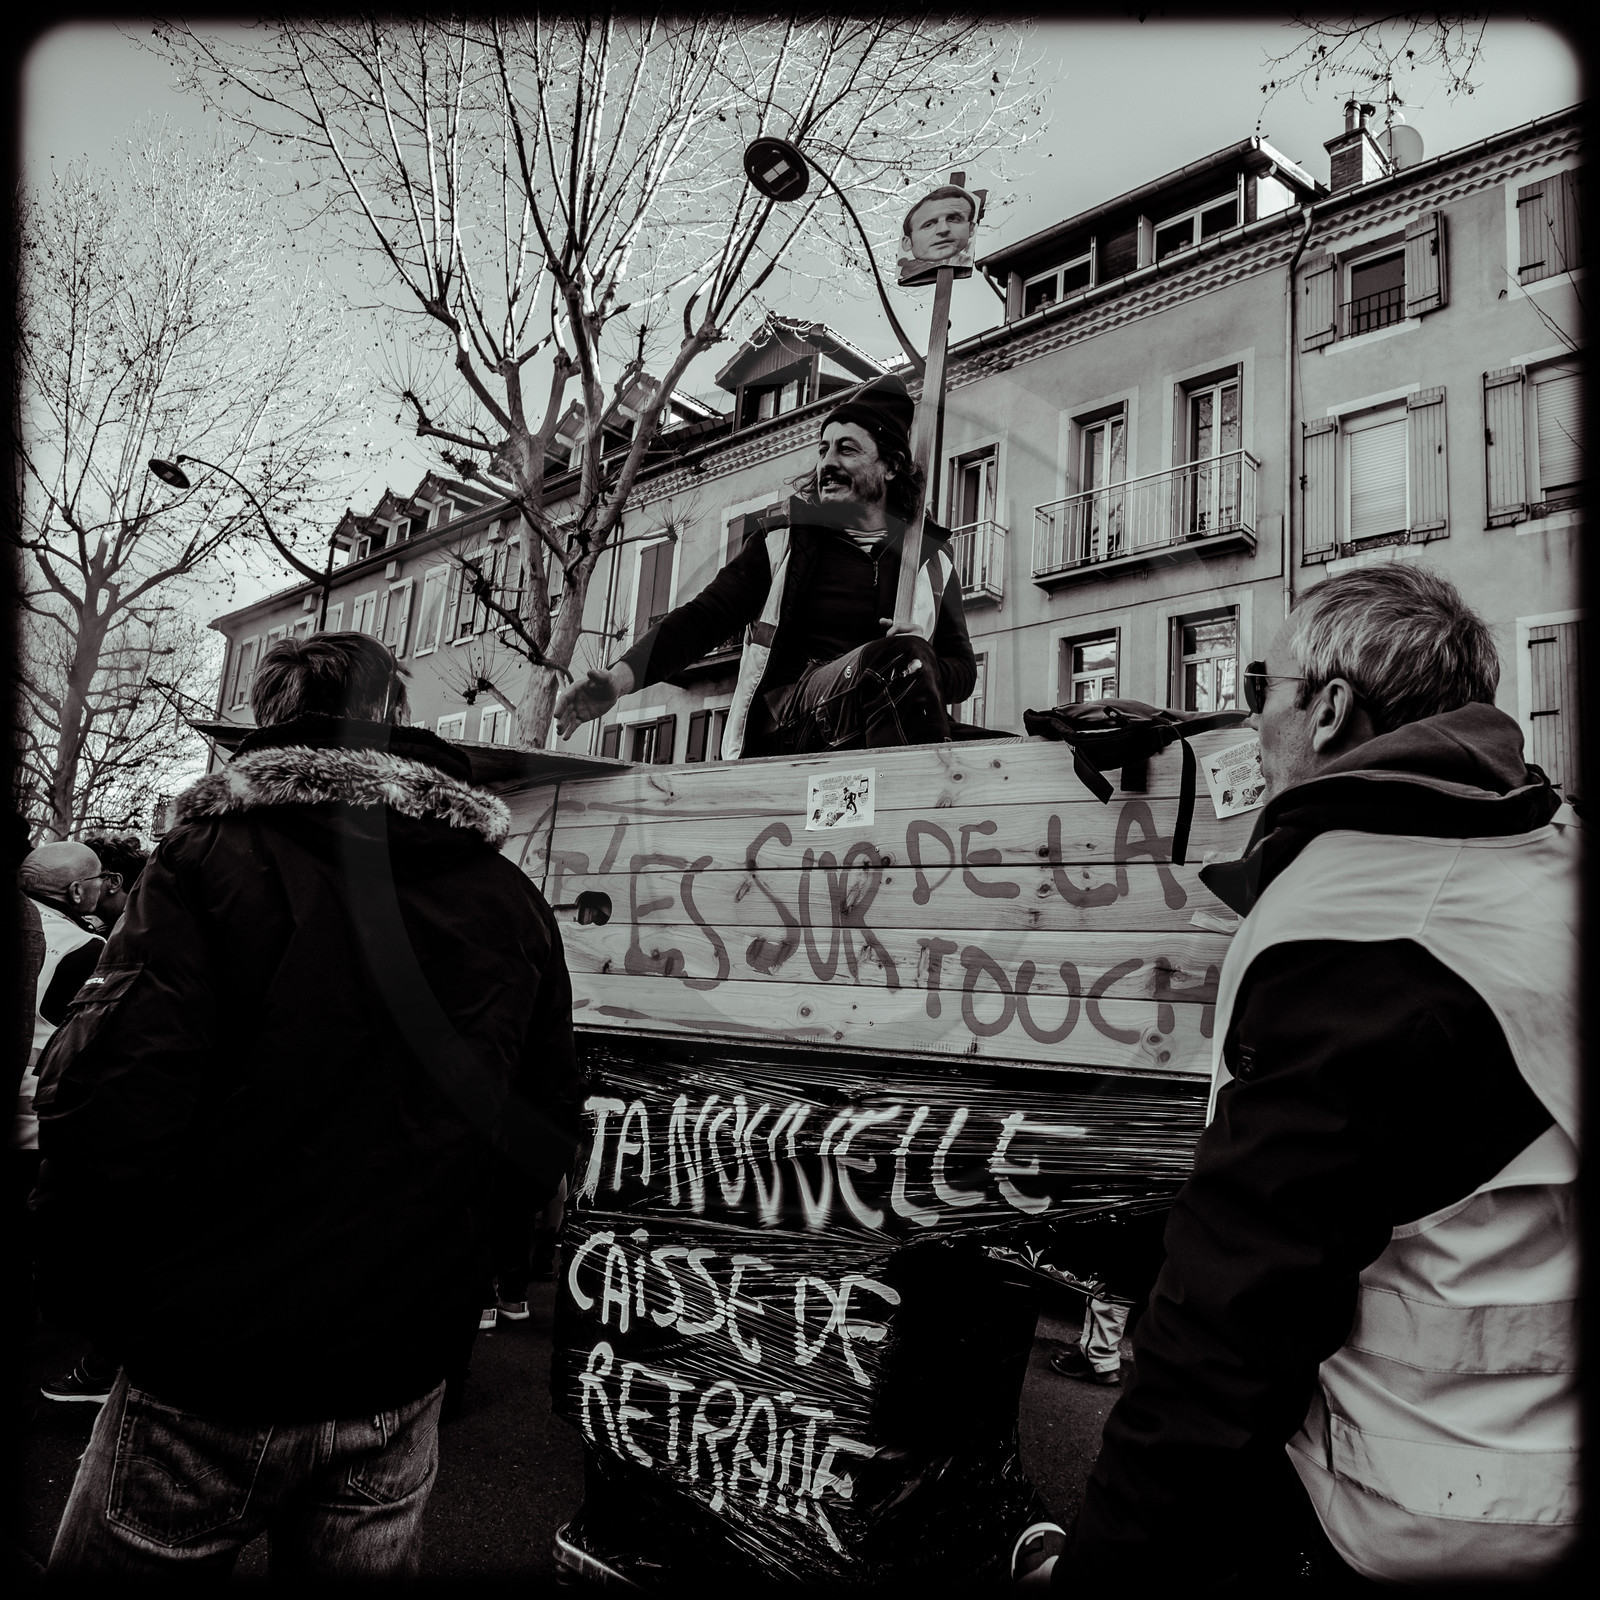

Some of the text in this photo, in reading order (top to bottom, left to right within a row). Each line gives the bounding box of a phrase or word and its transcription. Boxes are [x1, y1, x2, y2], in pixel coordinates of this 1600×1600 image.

[745, 822, 901, 994] SUR
[906, 819, 1021, 905] DE
[1047, 800, 1188, 910] LA
[584, 1093, 1086, 1229] TA NOUVELLE
[795, 1274, 901, 1386] DE
